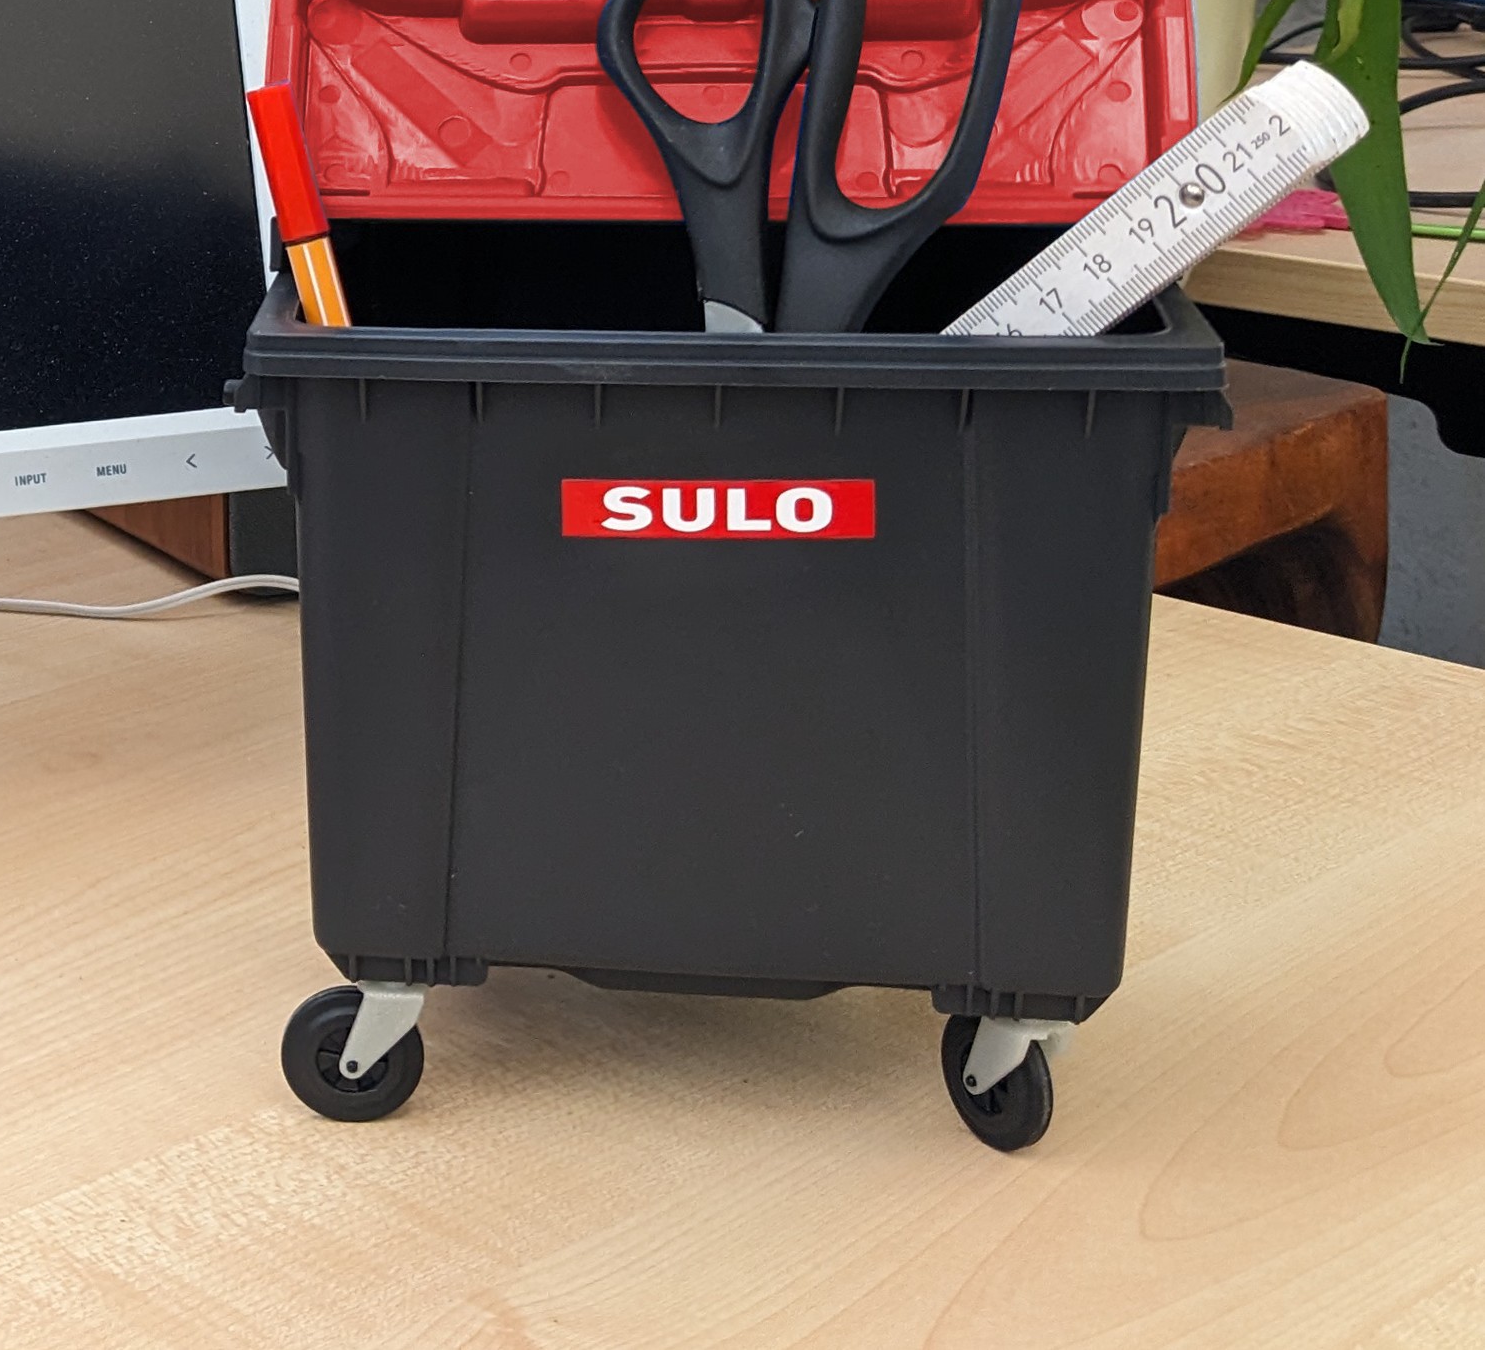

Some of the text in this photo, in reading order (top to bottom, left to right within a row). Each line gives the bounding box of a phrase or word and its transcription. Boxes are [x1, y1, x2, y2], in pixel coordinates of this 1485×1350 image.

[1039, 287, 1063, 315] 17
[1083, 253, 1112, 280] 18
[1128, 217, 1155, 244] 19
[1153, 163, 1226, 229] 20
[1222, 143, 1254, 173] 21
[1268, 114, 1291, 137] 2
[14, 472, 47, 487] INPUT
[96, 463, 127, 477] MENU
[600, 486, 833, 533] SULO
